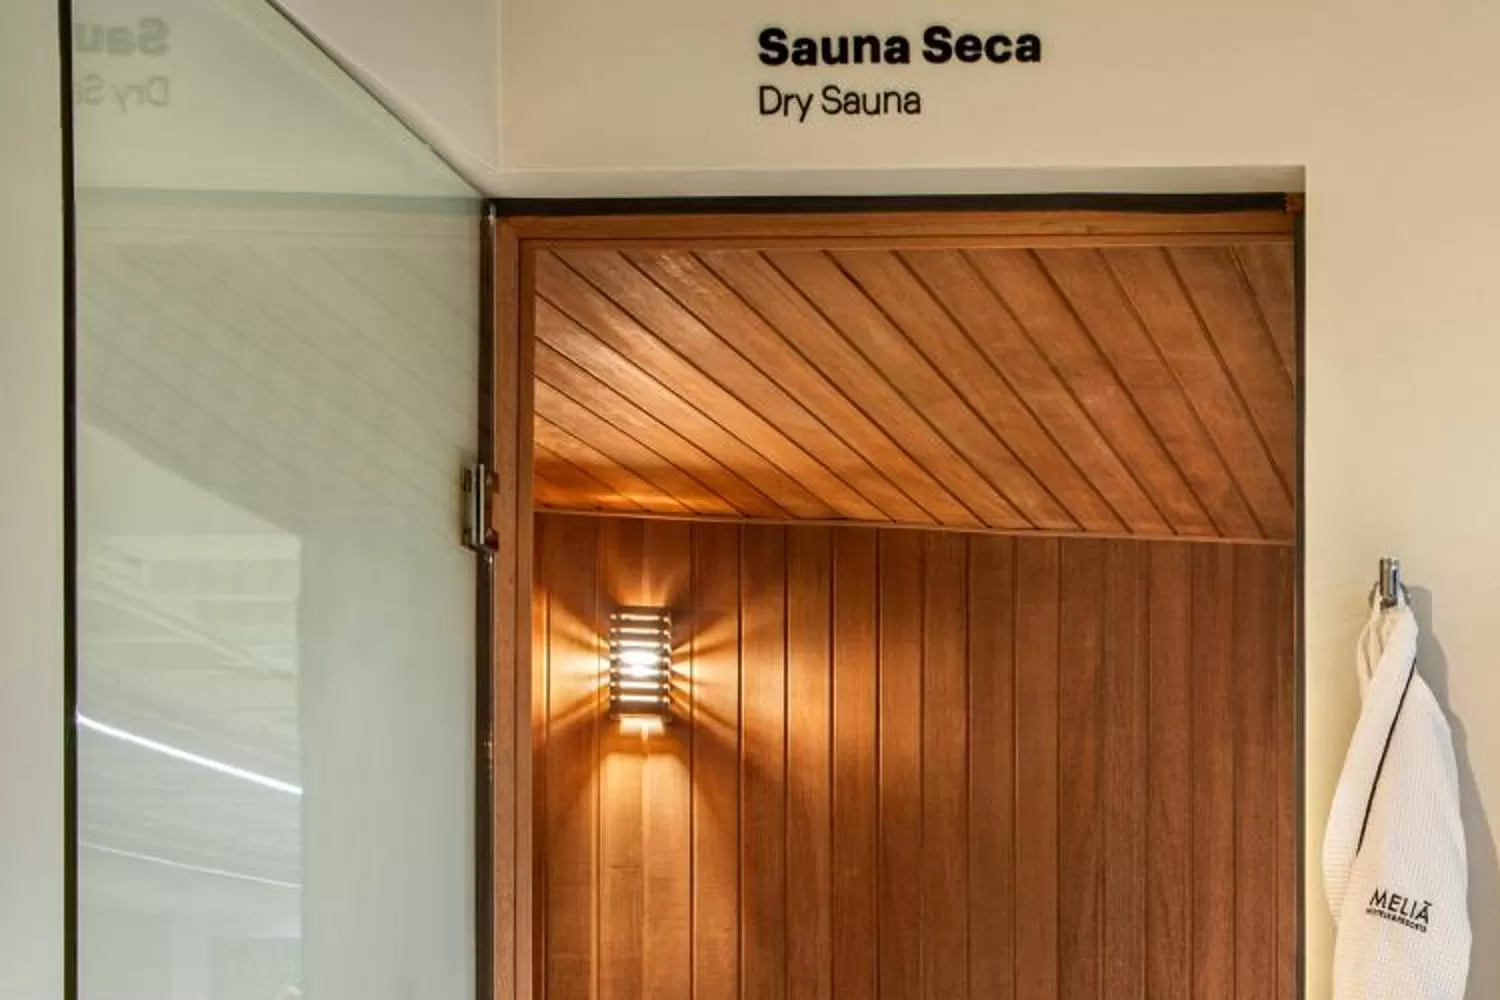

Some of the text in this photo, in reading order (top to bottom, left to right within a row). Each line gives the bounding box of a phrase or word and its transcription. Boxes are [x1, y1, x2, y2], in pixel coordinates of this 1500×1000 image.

[758, 25, 1042, 66] Sauna Seca
[758, 84, 922, 123] Dry Sauna
